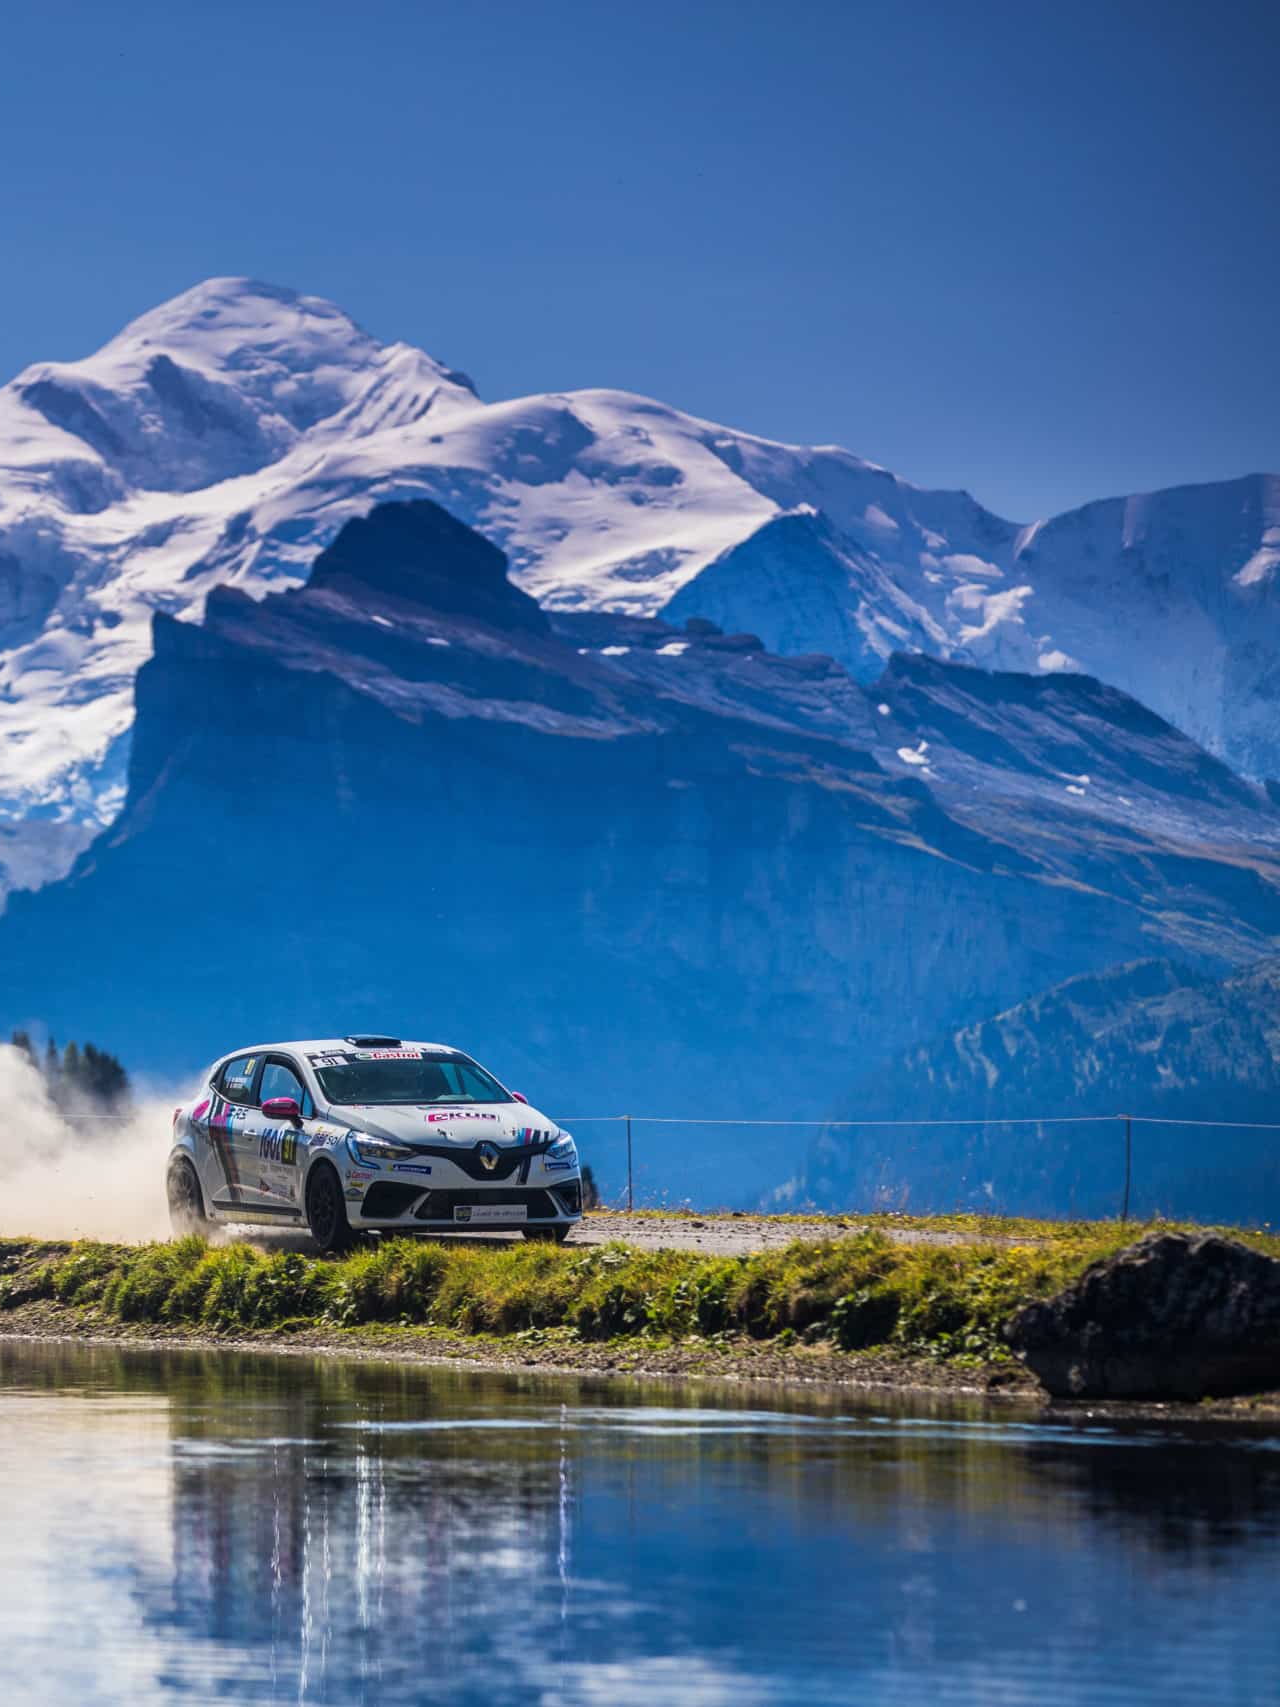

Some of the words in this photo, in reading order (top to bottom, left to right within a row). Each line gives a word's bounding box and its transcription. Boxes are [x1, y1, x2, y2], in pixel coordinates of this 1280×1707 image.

[322, 1057, 338, 1066] 91
[260, 1128, 284, 1161] IGOL
[284, 1135, 294, 1161] 91
